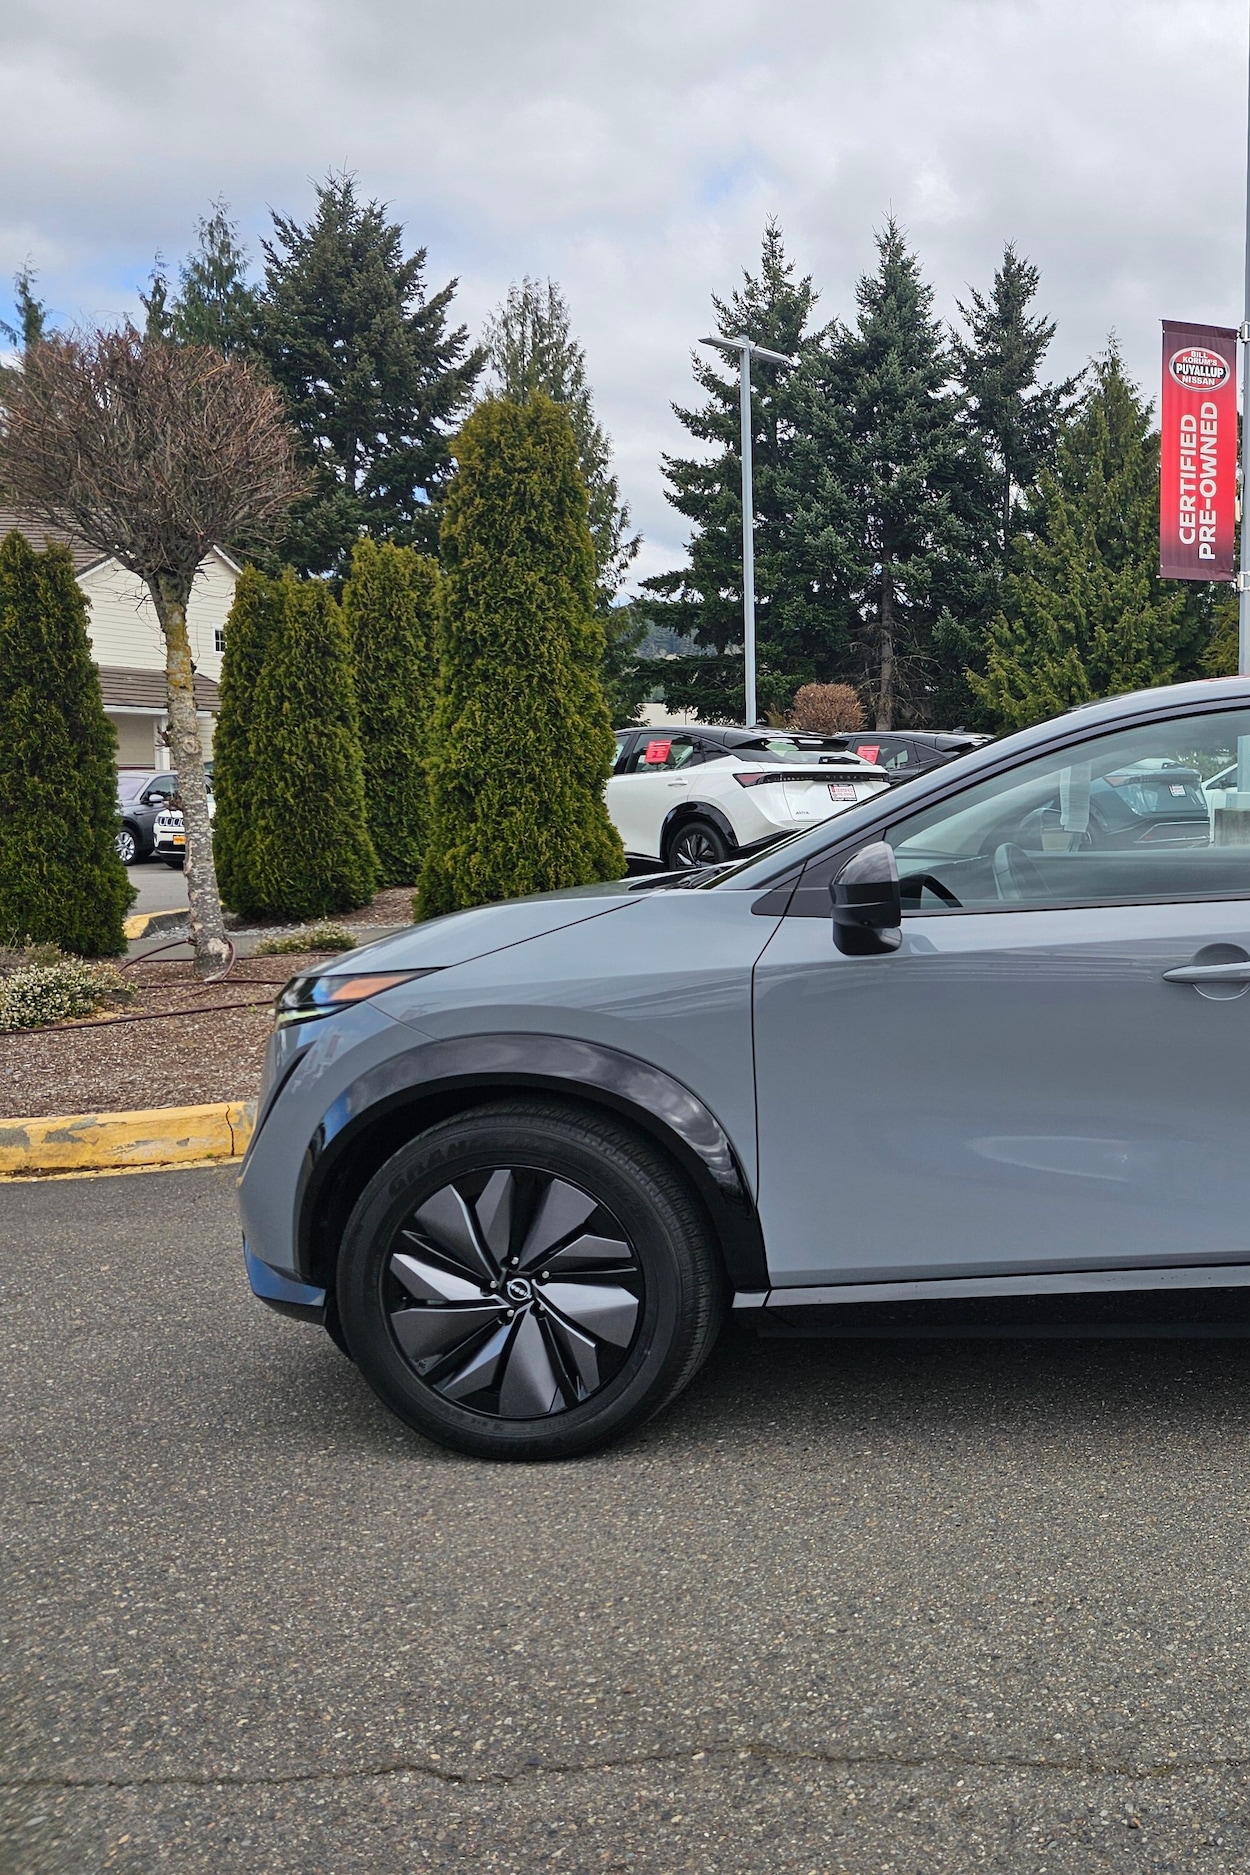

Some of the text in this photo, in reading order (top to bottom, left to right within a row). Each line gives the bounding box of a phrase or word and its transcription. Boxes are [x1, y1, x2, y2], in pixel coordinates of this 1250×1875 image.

[1182, 356, 1218, 366] KORUM'S
[1176, 363, 1224, 378] PUYALLUP
[1182, 376, 1216, 385] NISSAN
[1179, 414, 1197, 545] CERTIFIED
[1198, 402, 1218, 560] PRE-OWNED
